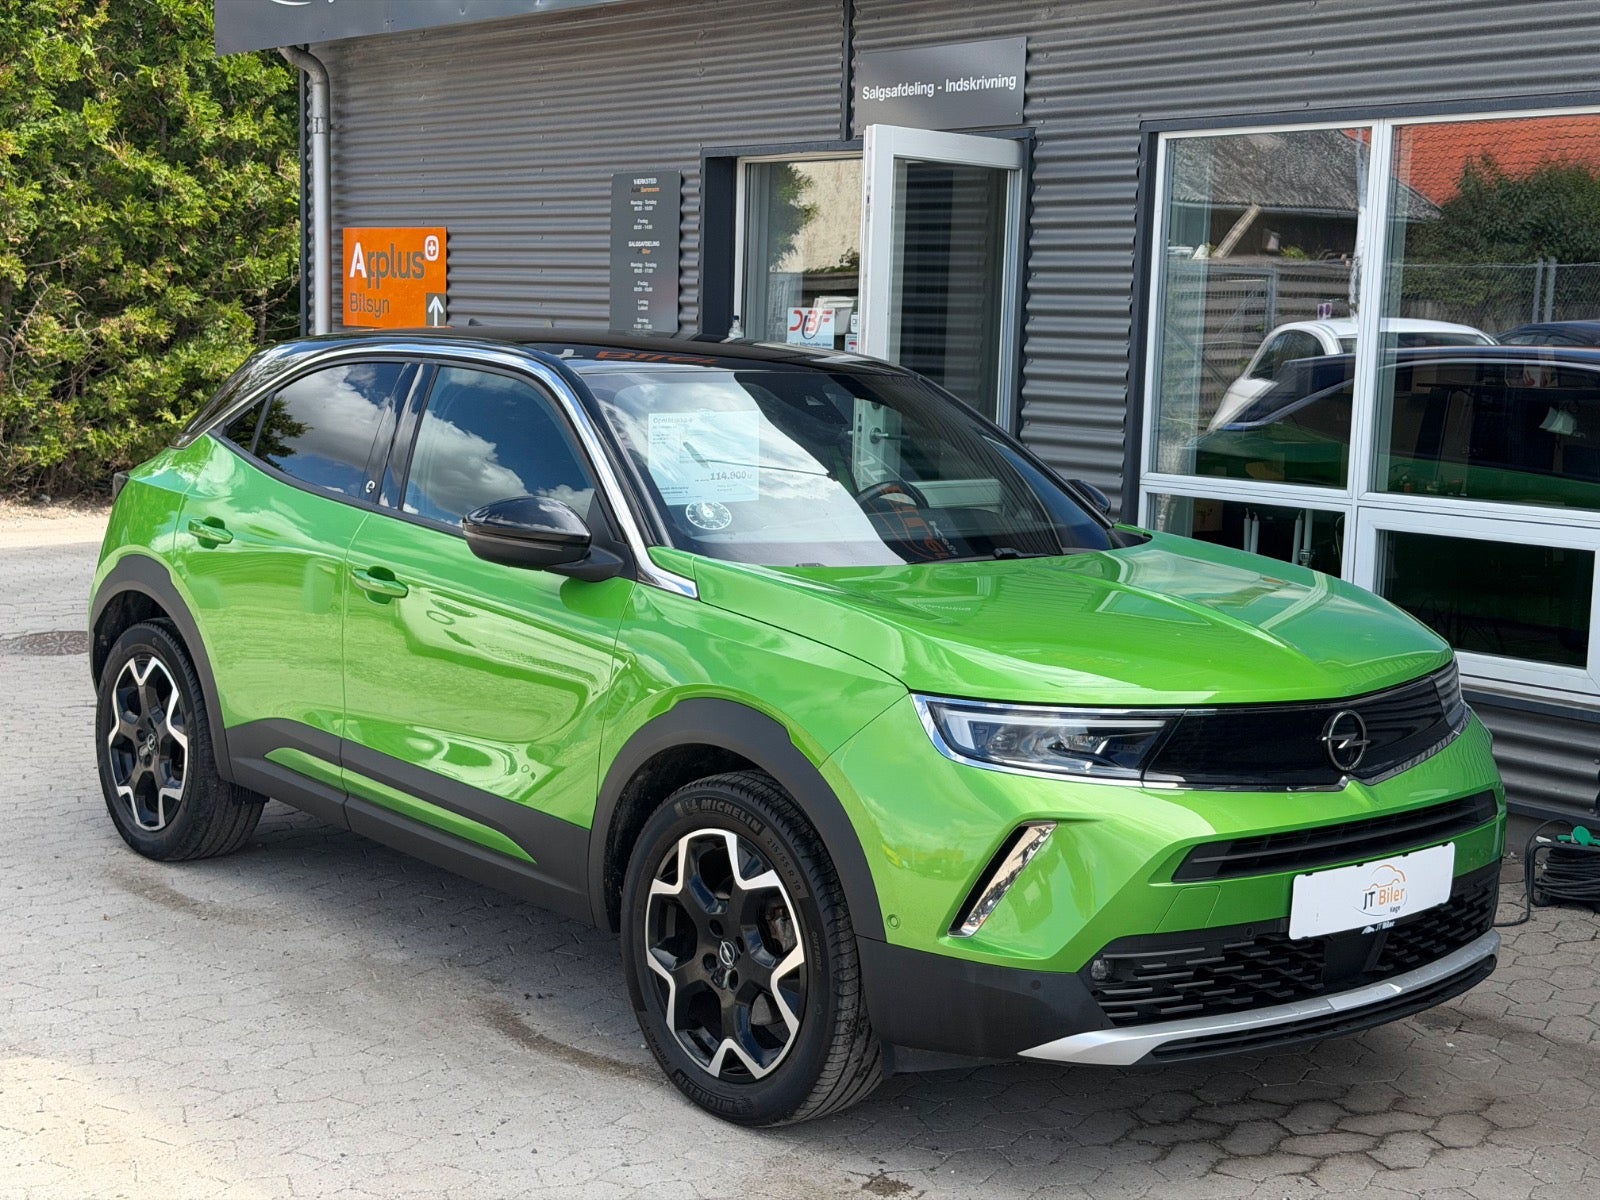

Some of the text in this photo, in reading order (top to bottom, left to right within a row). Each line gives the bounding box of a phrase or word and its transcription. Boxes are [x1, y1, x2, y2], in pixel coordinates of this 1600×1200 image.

[862, 82, 935, 101] Salgsafdeling
[945, 74, 1017, 93] Indskrivning
[350, 292, 389, 318] Bilsyn
[701, 799, 761, 833] MICHELIN
[1363, 887, 1405, 910] JT Biler
